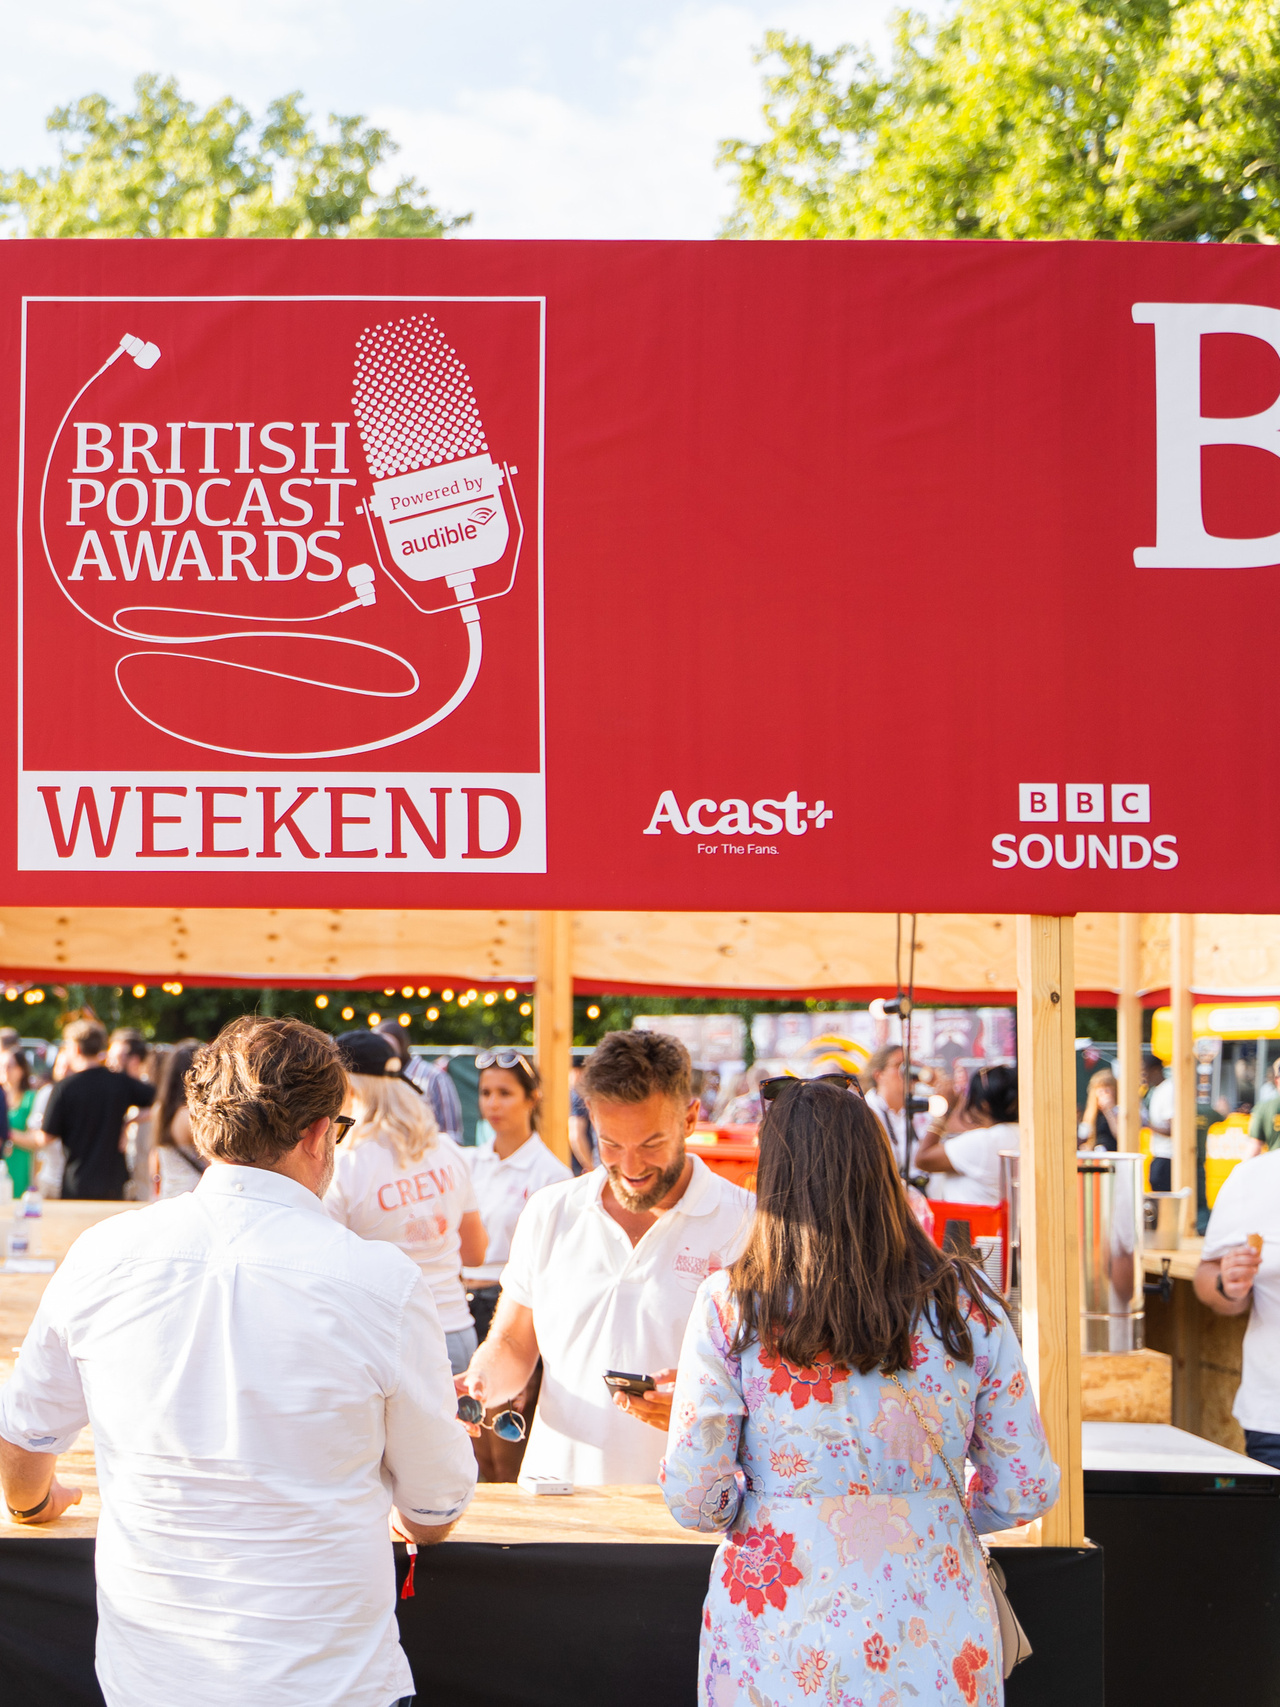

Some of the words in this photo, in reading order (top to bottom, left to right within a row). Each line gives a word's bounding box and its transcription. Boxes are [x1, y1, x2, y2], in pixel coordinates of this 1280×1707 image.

[73, 421, 350, 475] BRITISH
[65, 477, 357, 527] PODCAST
[390, 480, 461, 511] Powered
[463, 477, 483, 493] by
[67, 529, 344, 582] AWARDS
[400, 522, 478, 556] audible
[36, 785, 522, 860] WEEKEND
[1028, 790, 1141, 815] BBC
[697, 843, 719, 855] For
[721, 843, 745, 855] The
[747, 843, 780, 855] Fans.
[991, 833, 1179, 870] SOUNDS
[377, 1164, 455, 1212] CREW
